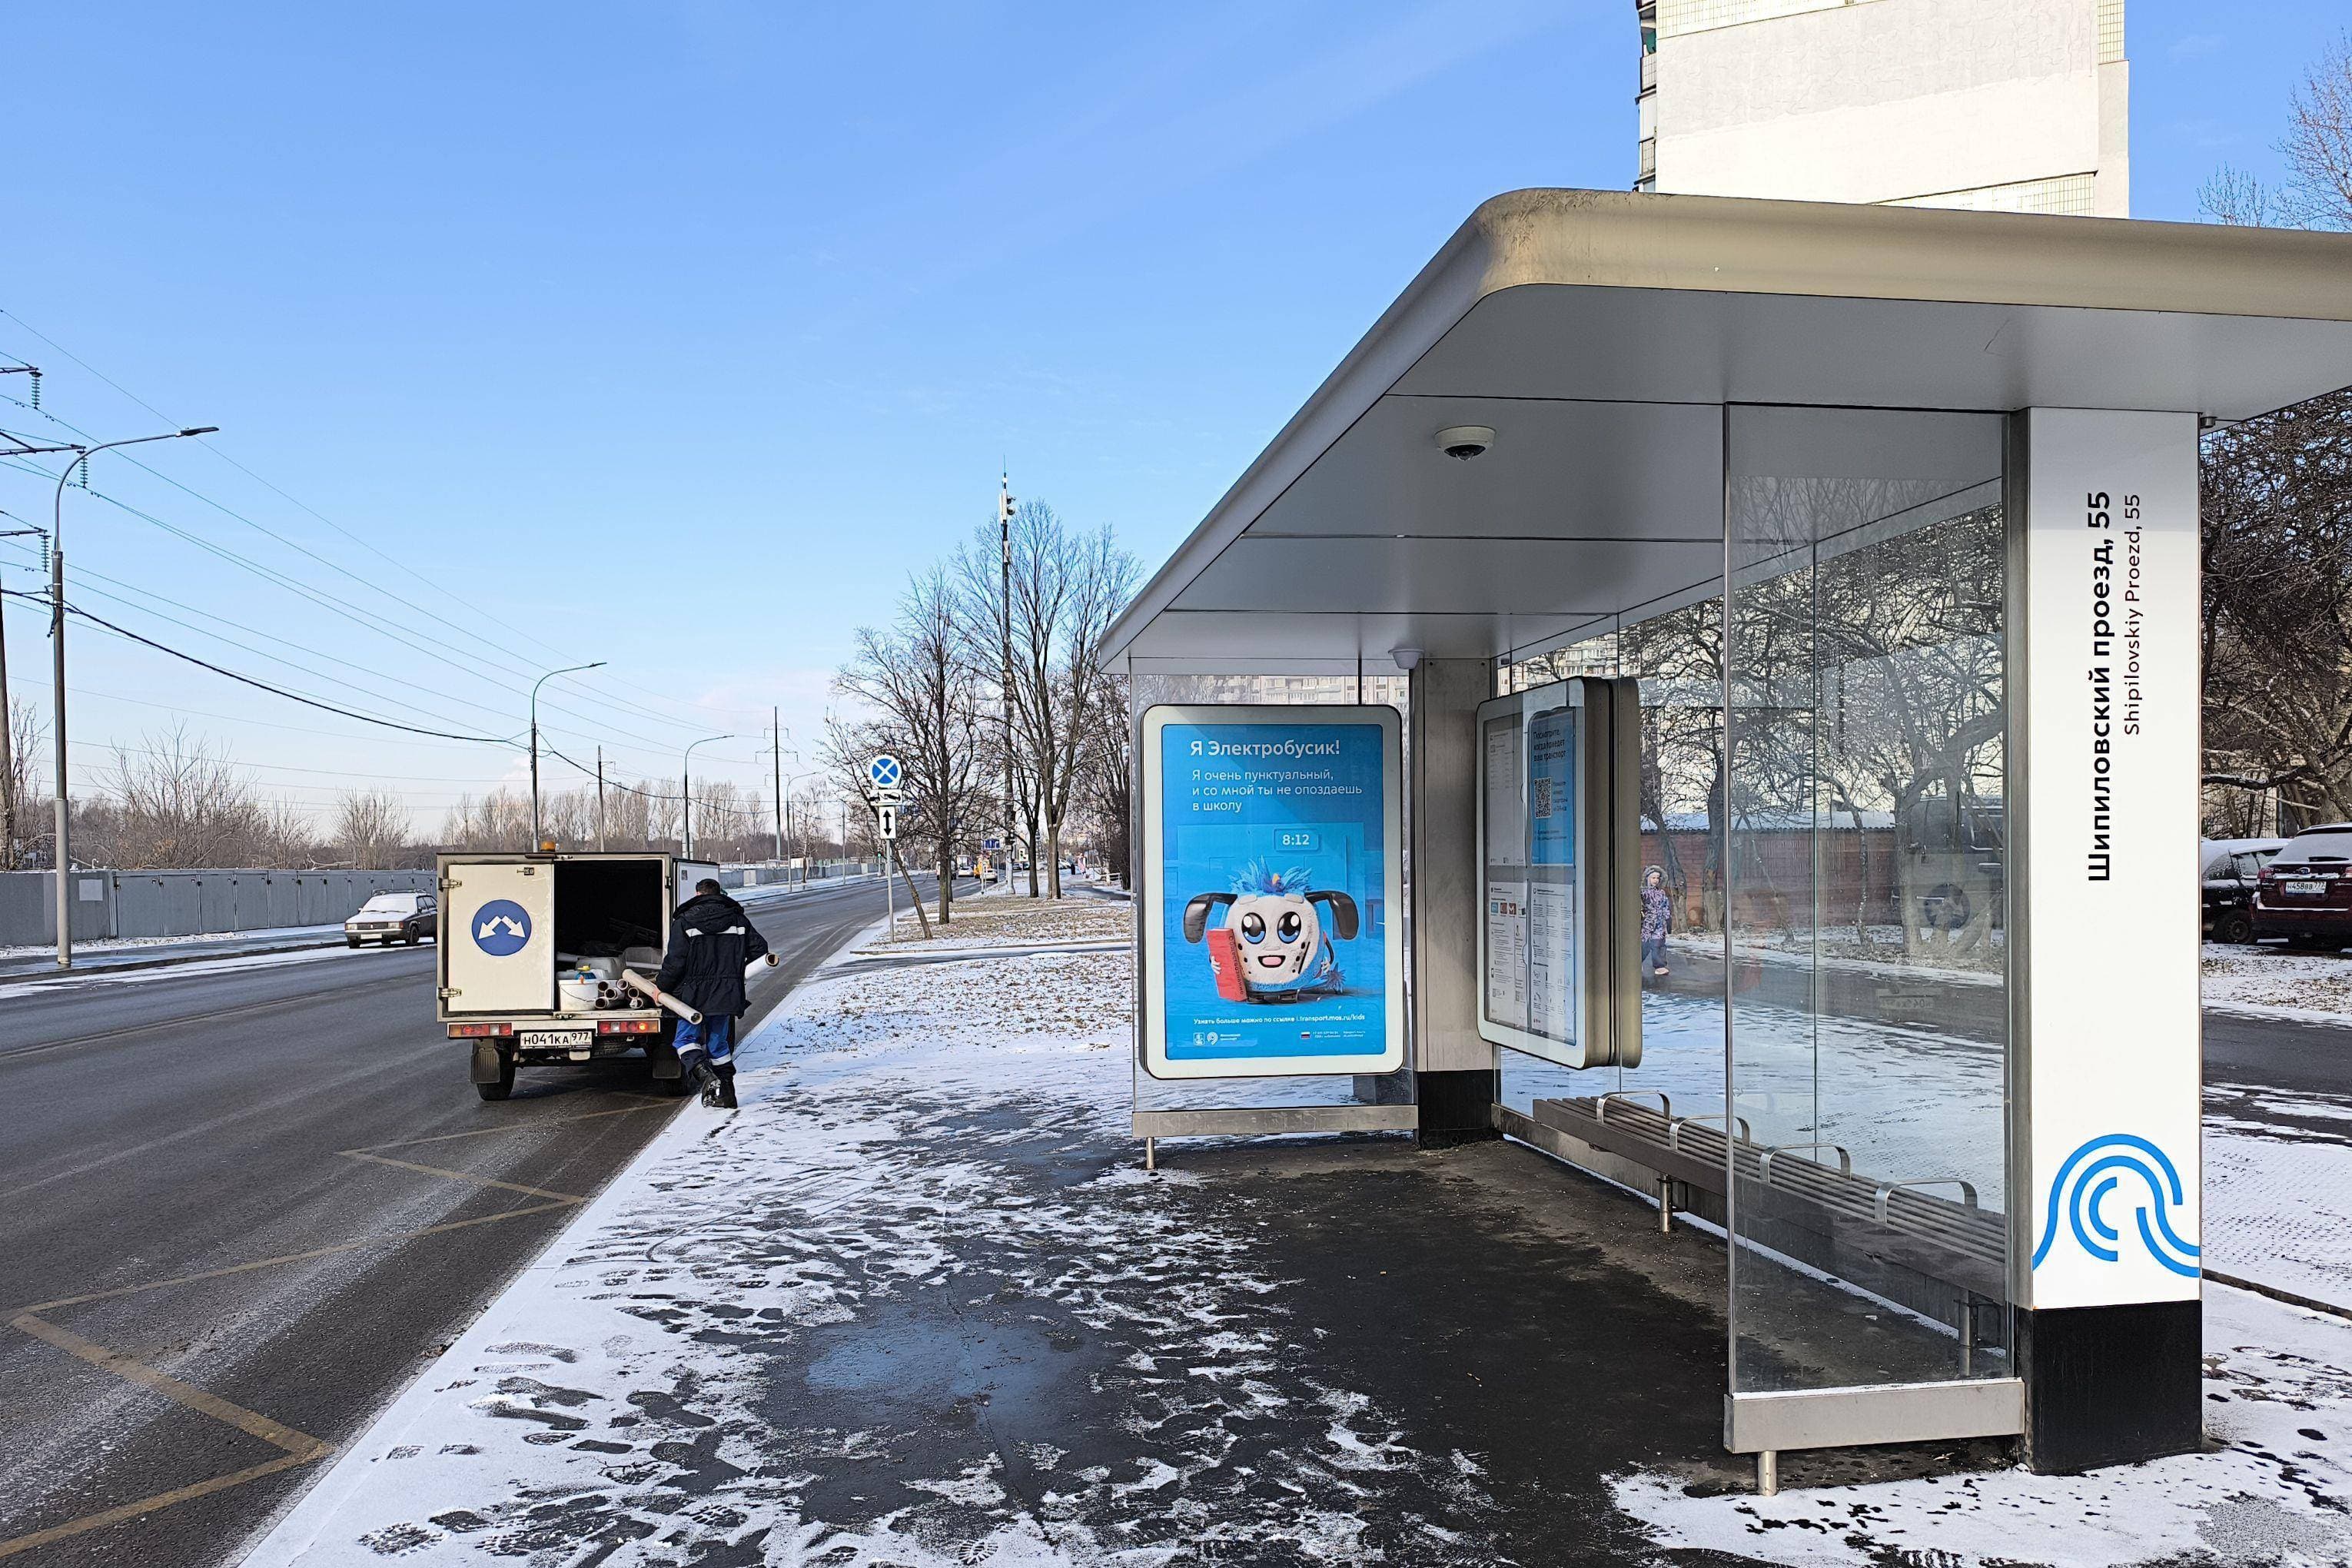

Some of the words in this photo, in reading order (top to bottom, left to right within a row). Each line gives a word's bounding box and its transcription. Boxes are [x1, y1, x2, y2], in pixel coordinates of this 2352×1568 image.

[2088, 492, 2110, 530] 55
[2124, 494, 2140, 520] 55
[2124, 526, 2143, 602] Proezd,
[2093, 539, 2114, 656] проезд,
[2124, 608, 2144, 735] Shipilovskiy
[1191, 740, 1203, 756] Я
[1208, 739, 1340, 759] Электробусик!
[1192, 769, 1201, 781] Я
[1204, 771, 1241, 781] очень
[1244, 769, 1334, 782] пунктуальный,
[2088, 667, 2111, 881] Шипиловский
[1192, 787, 1200, 796] и
[1203, 786, 1218, 796] со
[1221, 785, 1254, 796] мной
[1257, 786, 1273, 796] ты
[1277, 786, 1291, 795] не
[1294, 785, 1362, 796] опоздаешь
[1192, 802, 1200, 811] в
[1203, 801, 1242, 813] школу
[1282, 834, 1310, 845] 8:12
[572, 1032, 589, 1041] 977
